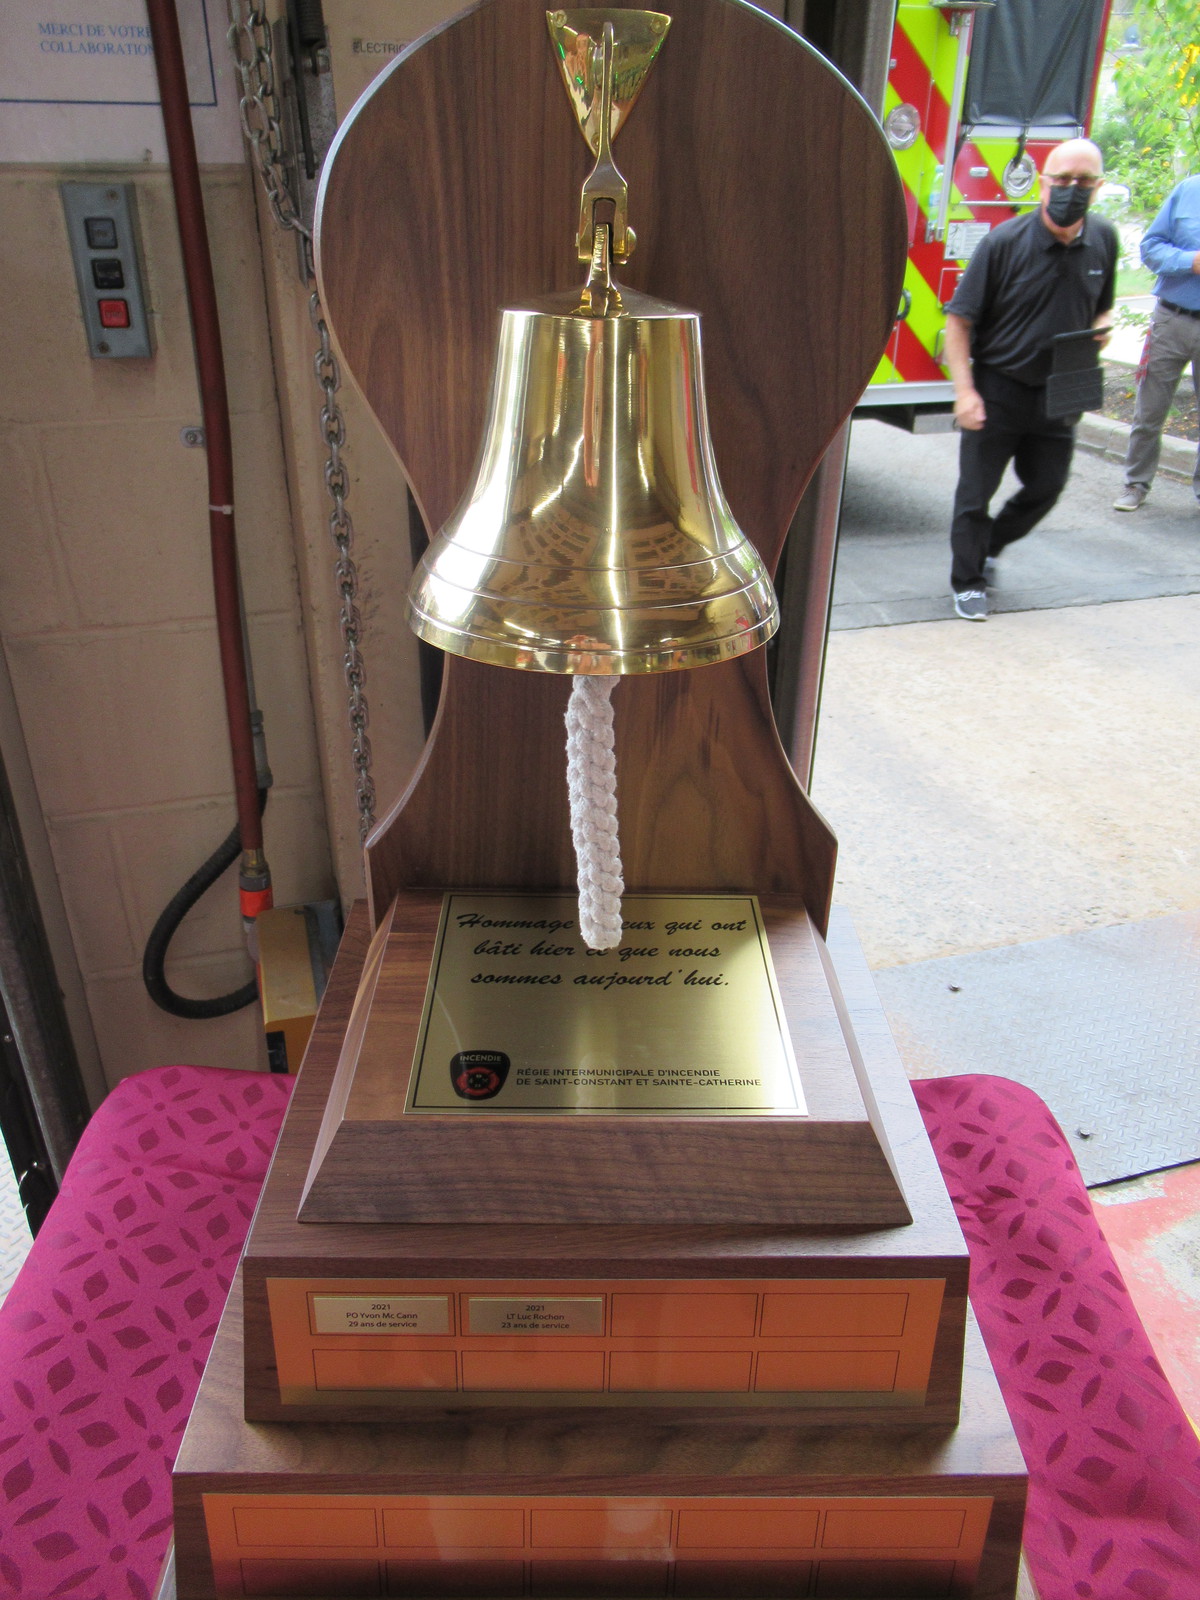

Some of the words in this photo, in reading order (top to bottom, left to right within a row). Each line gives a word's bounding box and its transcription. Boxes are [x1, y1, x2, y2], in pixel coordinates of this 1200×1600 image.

[38, 23, 83, 36] MERCI
[86, 24, 105, 37] DE
[457, 913, 574, 934] Hommage
[620, 920, 656, 930] eux
[664, 919, 702, 935] qui
[711, 919, 747, 931] ont
[473, 940, 522, 956] bâti
[530, 940, 575, 956] hier
[618, 946, 659, 962] que
[668, 946, 721, 957] nous
[470, 972, 563, 985] sommes
[573, 969, 729, 990] aujourd'hui.
[460, 1054, 502, 1062] INCENDIE
[516, 1067, 550, 1076] RÉGIE
[553, 1068, 654, 1077] INTERMUNICIPALE
[657, 1069, 721, 1077] D'INCENDIE
[516, 1078, 532, 1086] DE
[534, 1078, 633, 1086] SAINT-CONSTANT
[635, 1078, 650, 1086] ET
[652, 1079, 762, 1087] SAINTE-CATHERINE
[501, 1321, 512, 1329] 23
[528, 1321, 540, 1329] de
